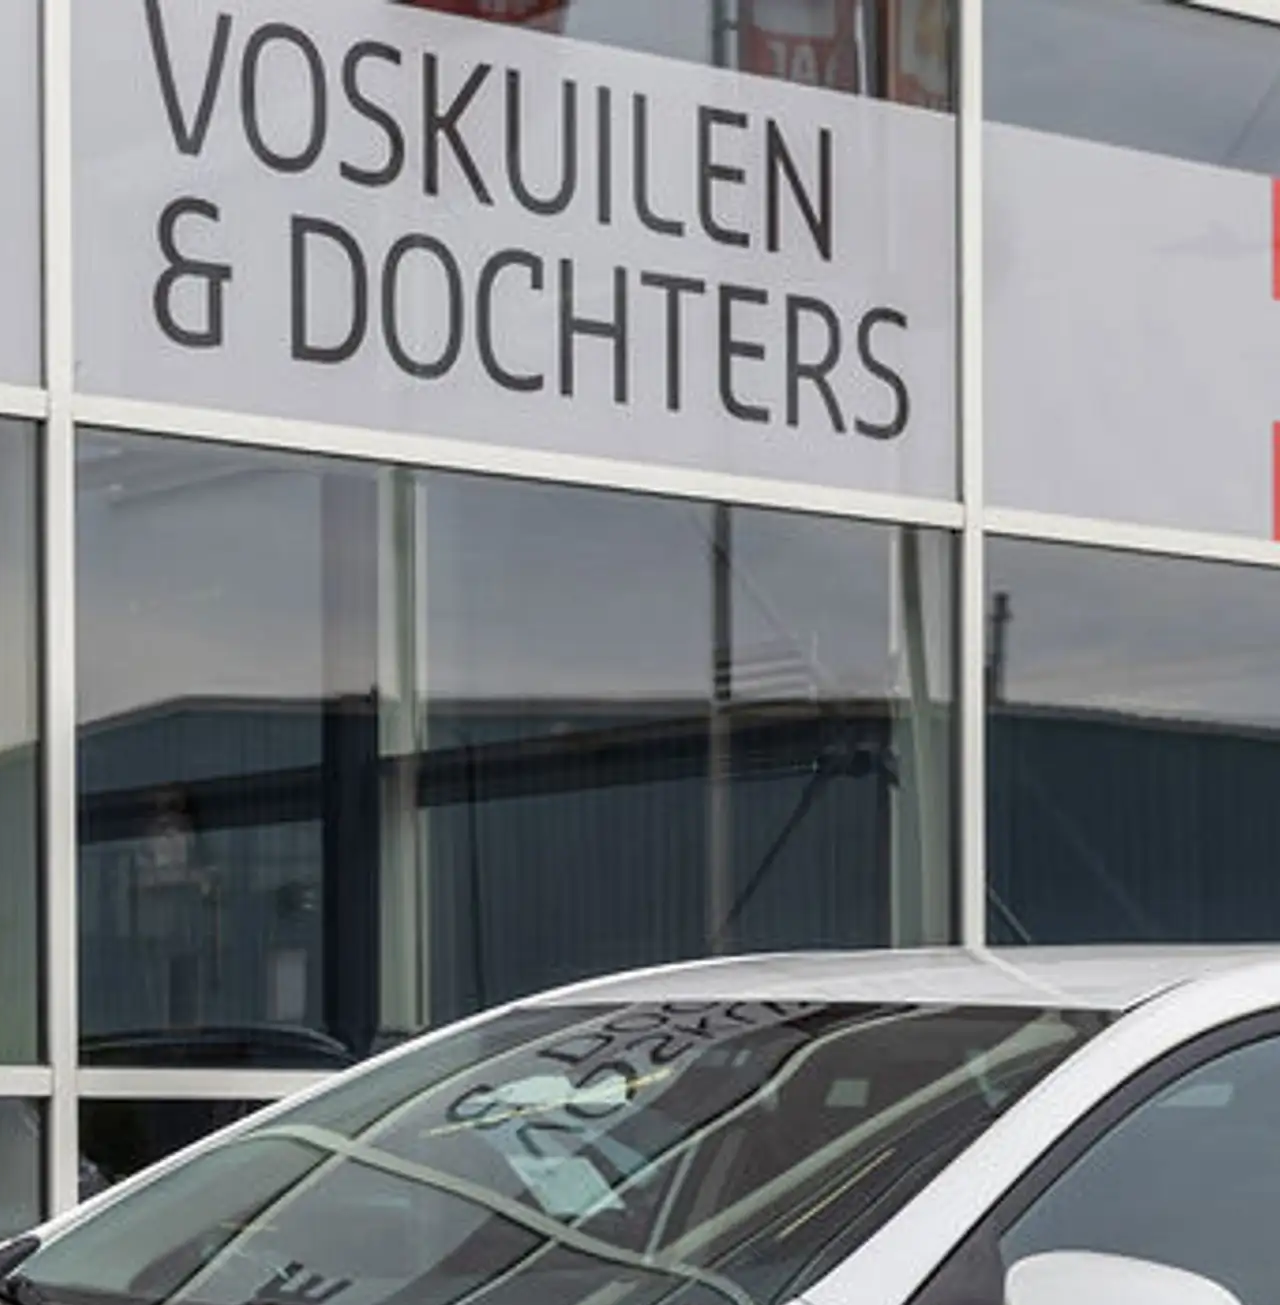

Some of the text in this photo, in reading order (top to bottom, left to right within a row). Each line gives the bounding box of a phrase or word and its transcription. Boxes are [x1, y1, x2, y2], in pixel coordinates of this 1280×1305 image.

[146, 0, 832, 262] VOSKUILEN
[153, 197, 910, 440] & DOCHTERS
